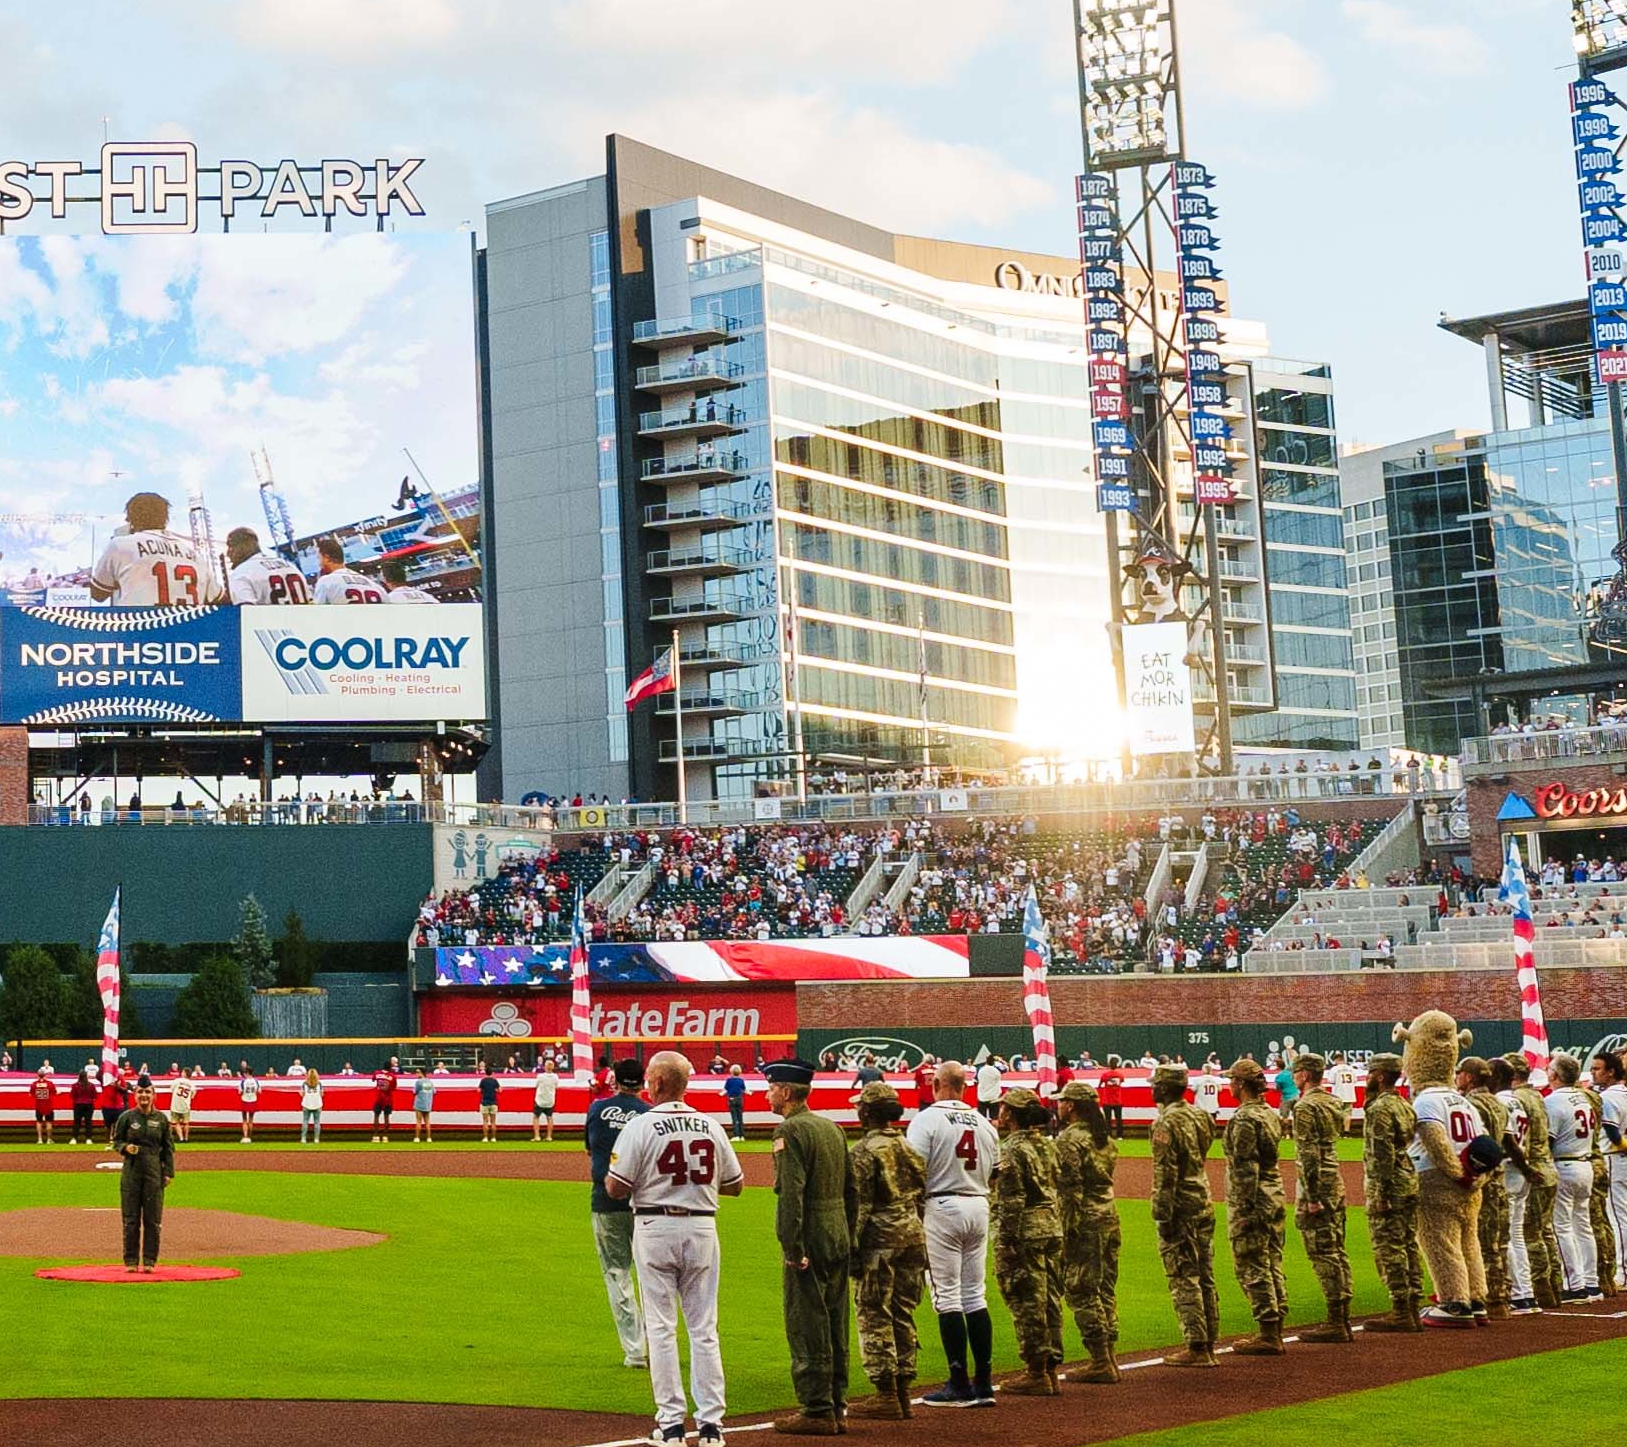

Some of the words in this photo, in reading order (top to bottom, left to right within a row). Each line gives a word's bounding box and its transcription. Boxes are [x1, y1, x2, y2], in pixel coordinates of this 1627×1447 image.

[1575, 85, 1605, 103] 1996
[1579, 118, 1608, 137] 1998
[1582, 153, 1612, 170] 2000
[1177, 168, 1204, 183] 1873
[219, 158, 426, 218] PARK
[1081, 180, 1108, 195] 1872
[1585, 186, 1615, 204] 2002
[1179, 199, 1206, 214] 1875
[1084, 211, 1110, 226] 1874
[1181, 229, 1209, 244] 1878
[1588, 220, 1619, 238] 2004
[1085, 241, 1111, 257] 1877
[1184, 261, 1211, 276] 1891
[1592, 254, 1620, 270] 2010
[1088, 272, 1115, 287] 1883
[1186, 292, 1214, 307] 1893
[1595, 289, 1624, 305] 2013
[1090, 303, 1117, 318] 1892
[1188, 324, 1217, 339] 1898
[1598, 323, 1627, 340] 2019
[1092, 334, 1118, 349] 1897
[1190, 355, 1219, 370] 1948
[1094, 365, 1120, 380] 1914
[1193, 387, 1221, 402] 1958
[1096, 396, 1122, 411] 1957
[1195, 418, 1224, 434] 1982
[1098, 427, 1125, 442] 1969
[1197, 450, 1226, 466] 1992
[1100, 458, 1127, 475] 1991
[1102, 490, 1130, 506] 1993
[1200, 482, 1228, 498] 1995
[152, 562, 198, 604] 13
[269, 574, 305, 604] 20
[21, 642, 220, 666] NORTHSIDE
[275, 636, 470, 670] COOLRAY
[1141, 652, 1170, 669] EAT
[57, 670, 184, 687] HOSPITAL
[330, 674, 374, 686] Cooling
[386, 673, 431, 686] Heating
[1141, 670, 1175, 688] MOR
[341, 685, 396, 697] Plumbing
[407, 684, 461, 695] Electrical
[1131, 690, 1184, 706] CHIKIN
[569, 1001, 760, 1038] tateFarm
[1188, 1033, 1209, 1044] 375
[116, 1047, 128, 1058] 00
[840, 1041, 908, 1072] Ford
[1341, 1073, 1352, 1083] 13
[177, 1085, 191, 1099] 35
[1204, 1085, 1215, 1095] 10
[653, 1117, 709, 1136] SNITKER
[946, 1111, 978, 1128] WEISS
[956, 1130, 977, 1171] 4
[657, 1139, 715, 1186] 43
